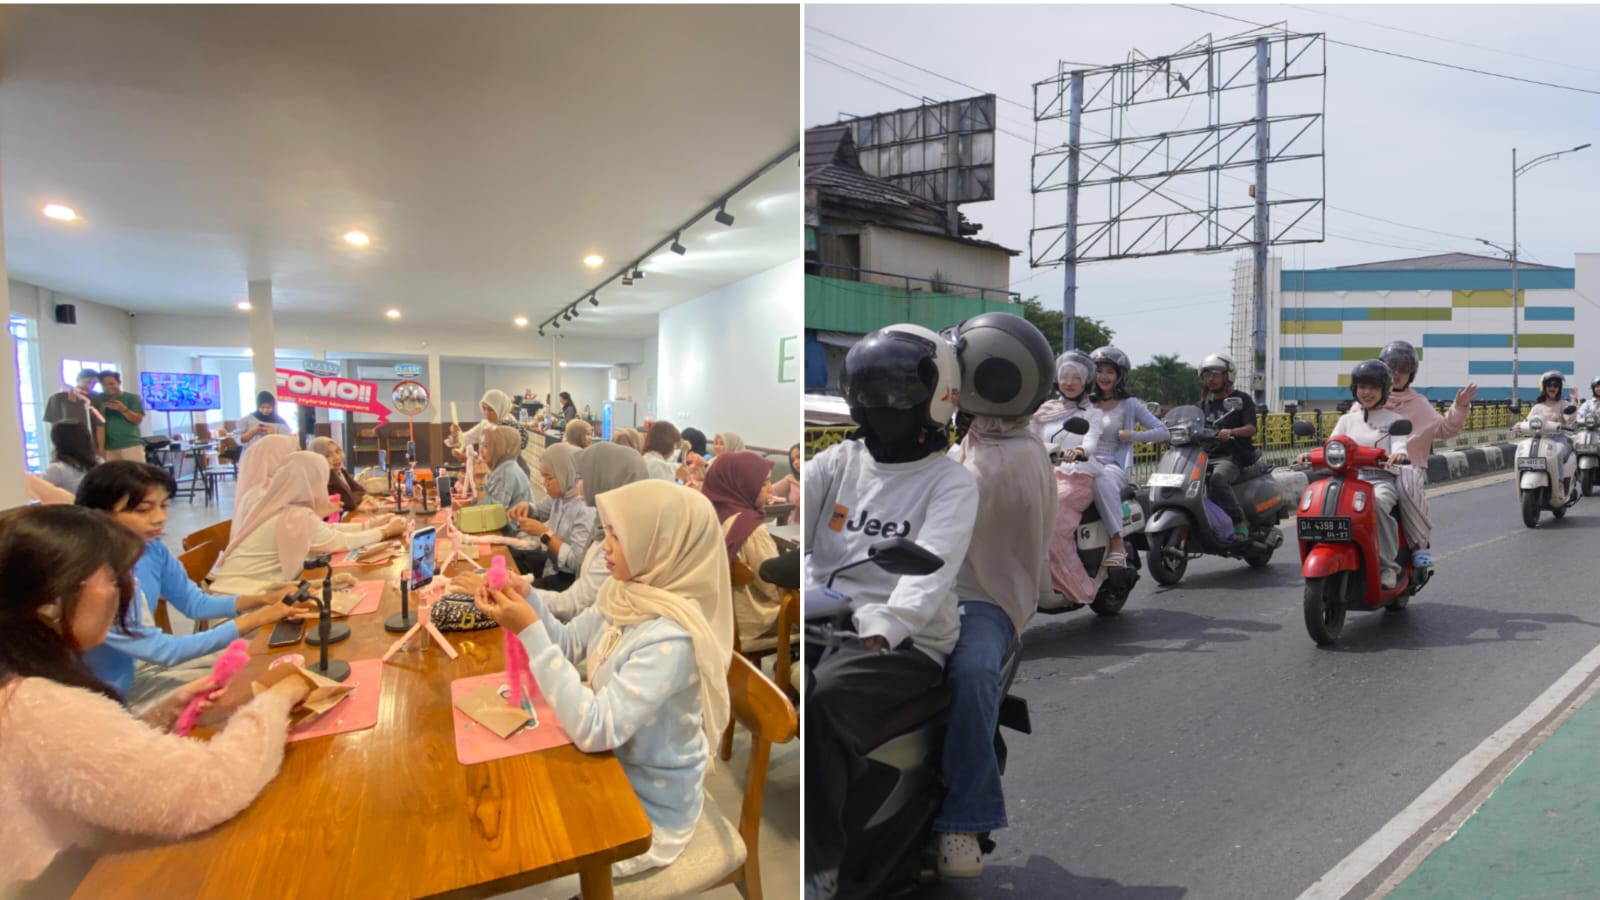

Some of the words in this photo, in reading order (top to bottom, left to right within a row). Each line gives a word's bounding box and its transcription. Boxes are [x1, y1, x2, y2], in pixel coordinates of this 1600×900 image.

[778, 335, 798, 383] E
[276, 373, 371, 403] FOMO!!
[298, 397, 328, 407] Hybrid
[329, 401, 370, 411] Movement
[1301, 521, 1312, 530] DA
[1338, 521, 1348, 530] AL
